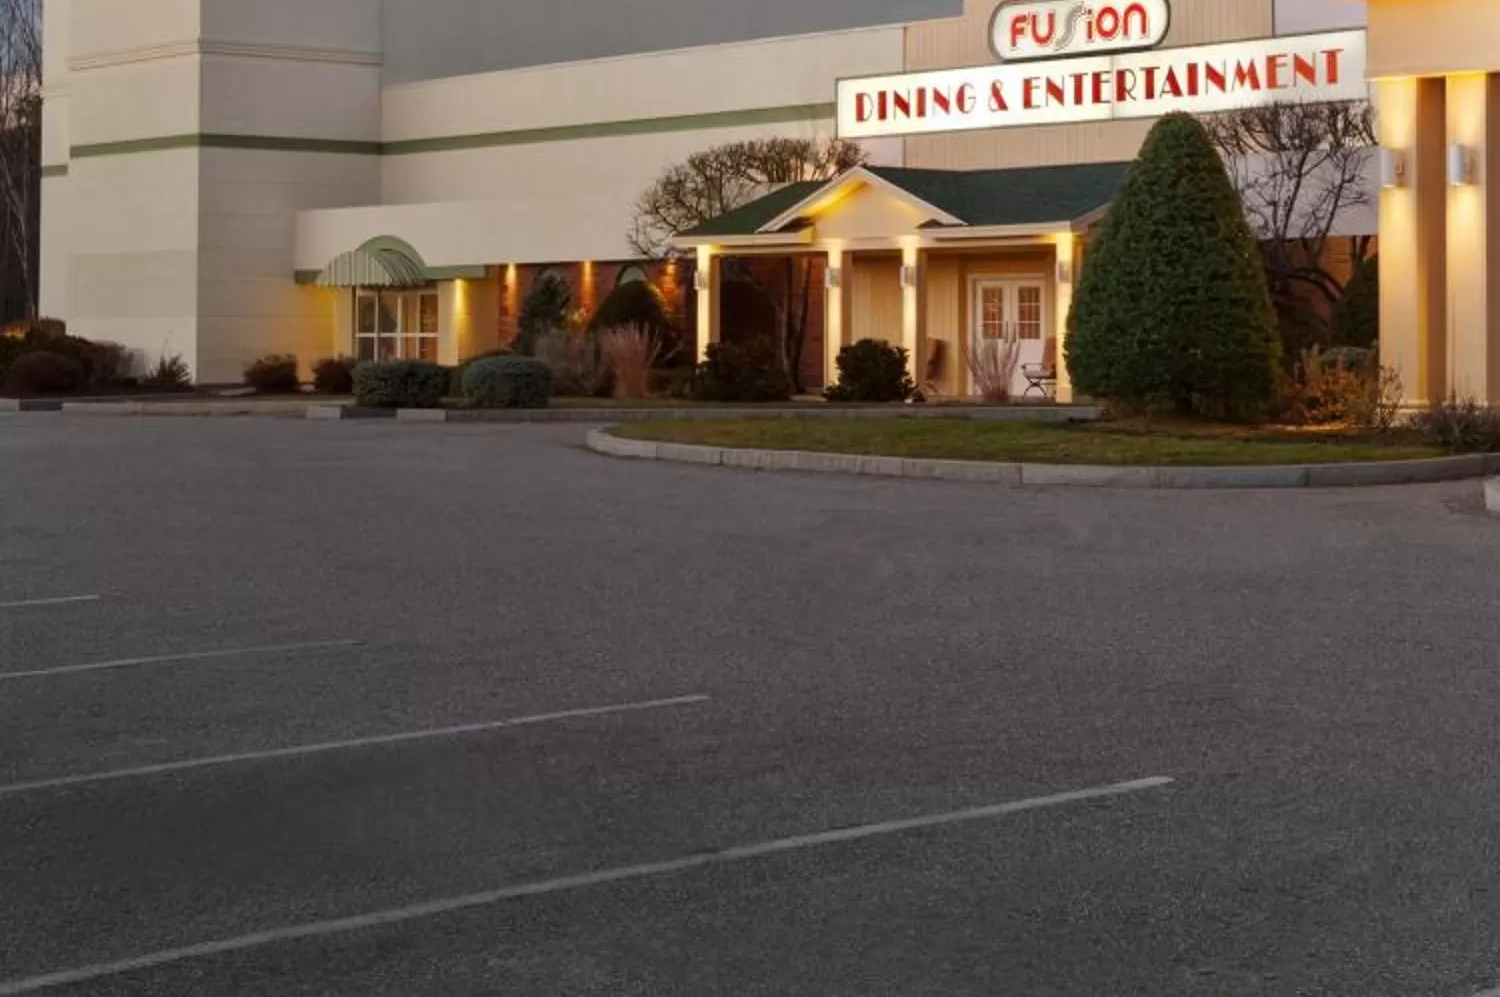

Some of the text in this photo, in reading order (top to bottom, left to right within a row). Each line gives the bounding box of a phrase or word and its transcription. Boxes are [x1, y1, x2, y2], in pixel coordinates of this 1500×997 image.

[856, 48, 1343, 123] DINING & ENTERTAINMENT
